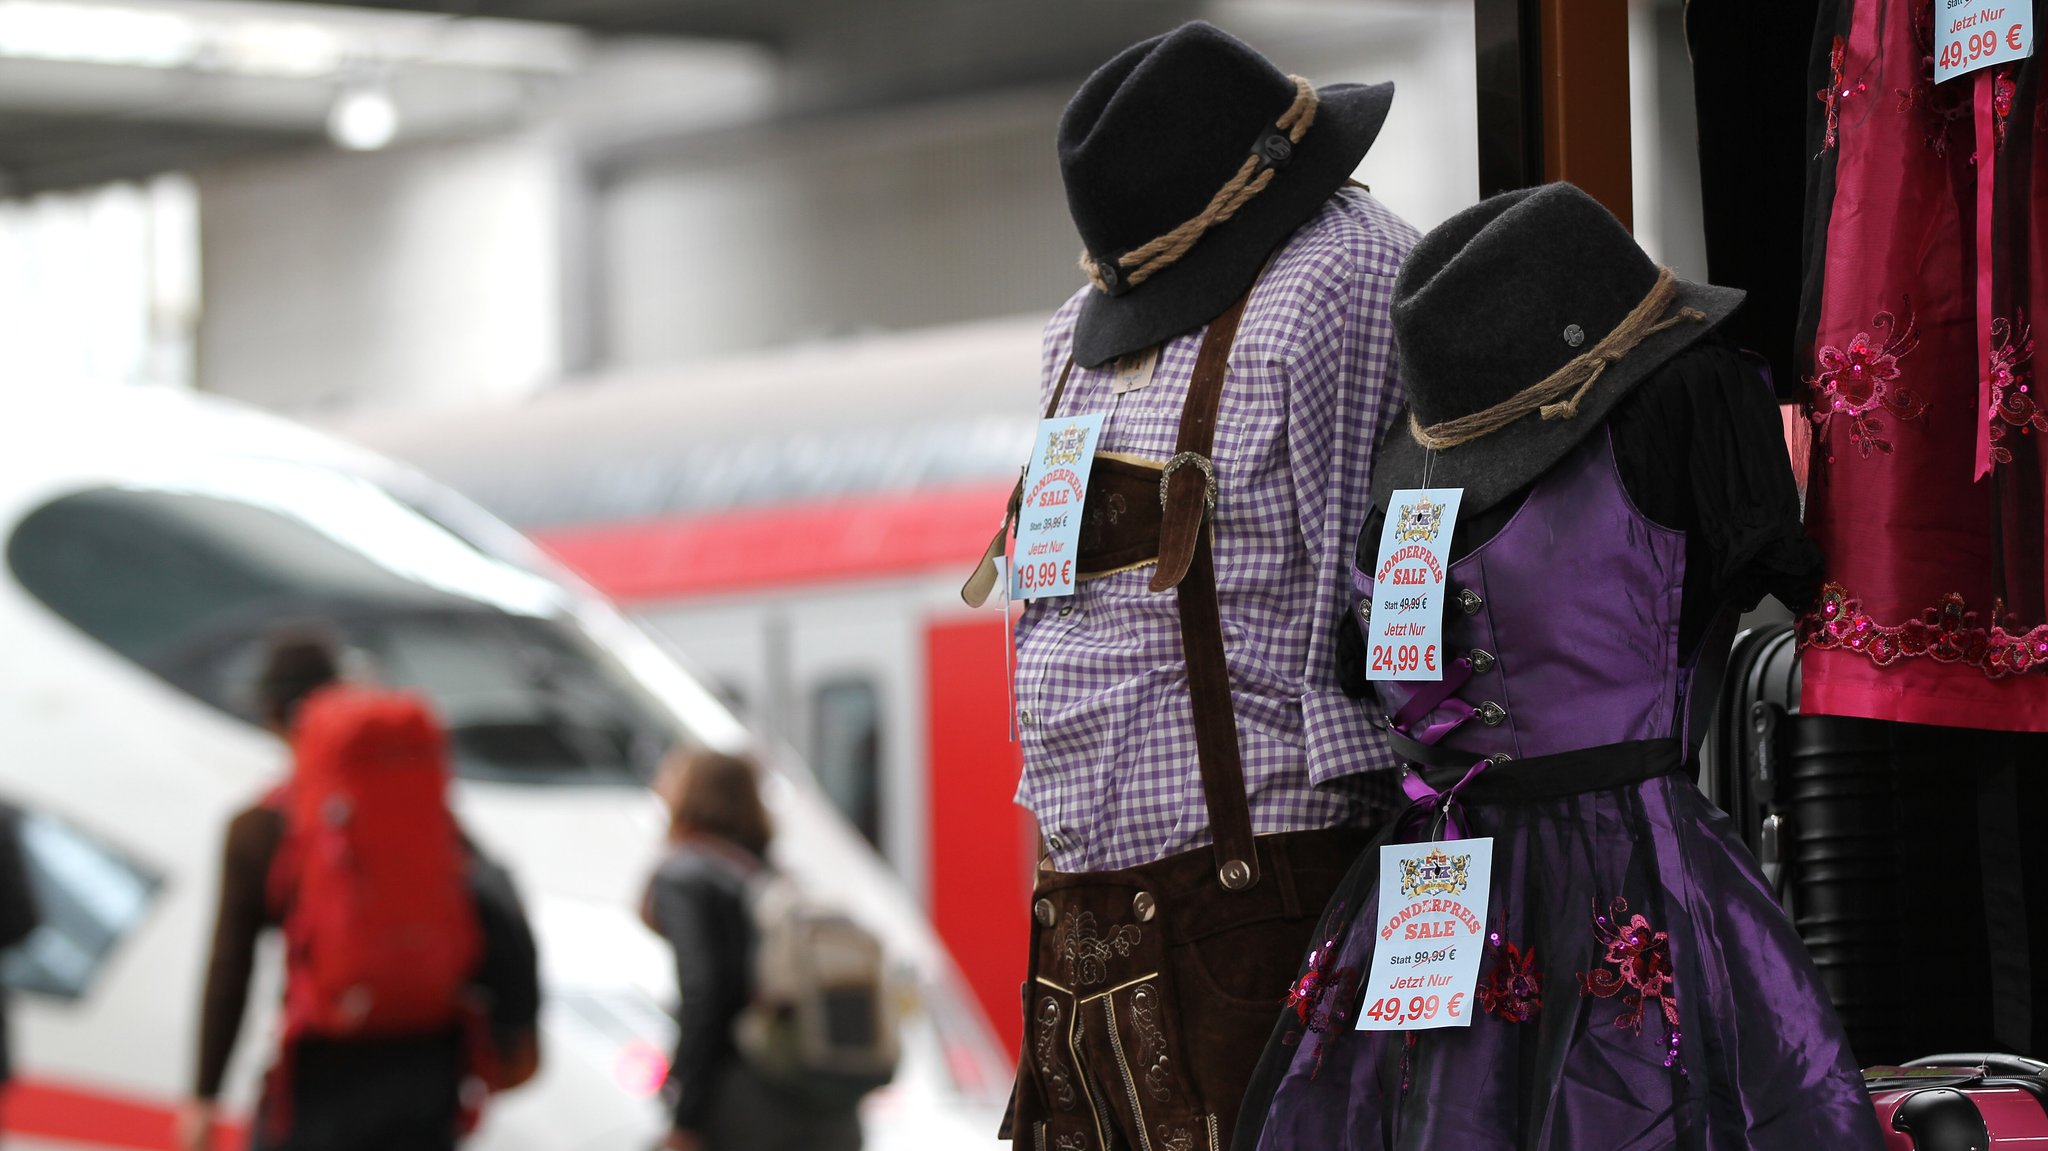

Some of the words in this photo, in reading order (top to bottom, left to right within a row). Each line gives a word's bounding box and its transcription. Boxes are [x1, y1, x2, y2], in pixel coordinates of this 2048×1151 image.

[1950, 13, 1977, 34] Jetzt
[1980, 8, 2005, 23] Nur
[1939, 30, 1997, 70] 49,99
[2006, 24, 2022, 50] €
[1026, 469, 1083, 508] SONDERPREIS
[1039, 489, 1069, 507] SALE
[1063, 516, 1067, 527] €
[1028, 542, 1048, 556] Jetzt
[1049, 540, 1064, 553] Nur
[1378, 545, 1443, 584] SONDERPREIS
[1018, 561, 1057, 593] 19,99
[1061, 559, 1071, 585] €
[1393, 568, 1427, 584] SALE
[1384, 601, 1398, 610] Statt
[1399, 597, 1420, 611] 49,99
[1422, 597, 1427, 609] €
[1384, 623, 1407, 636] Jetzt
[1409, 622, 1426, 636] Nur
[1372, 645, 1419, 676] 24,99
[1424, 645, 1436, 671] €
[1381, 899, 1481, 941] SONDERPREIS
[1404, 921, 1456, 940] SALE
[1390, 956, 1411, 965] Statt
[1414, 950, 1446, 964] 99,99
[1449, 949, 1457, 961] €
[1390, 976, 1425, 990] Jetzt
[1427, 973, 1453, 987] Nur
[1367, 994, 1440, 1026] 49,99
[1447, 992, 1465, 1018] €
